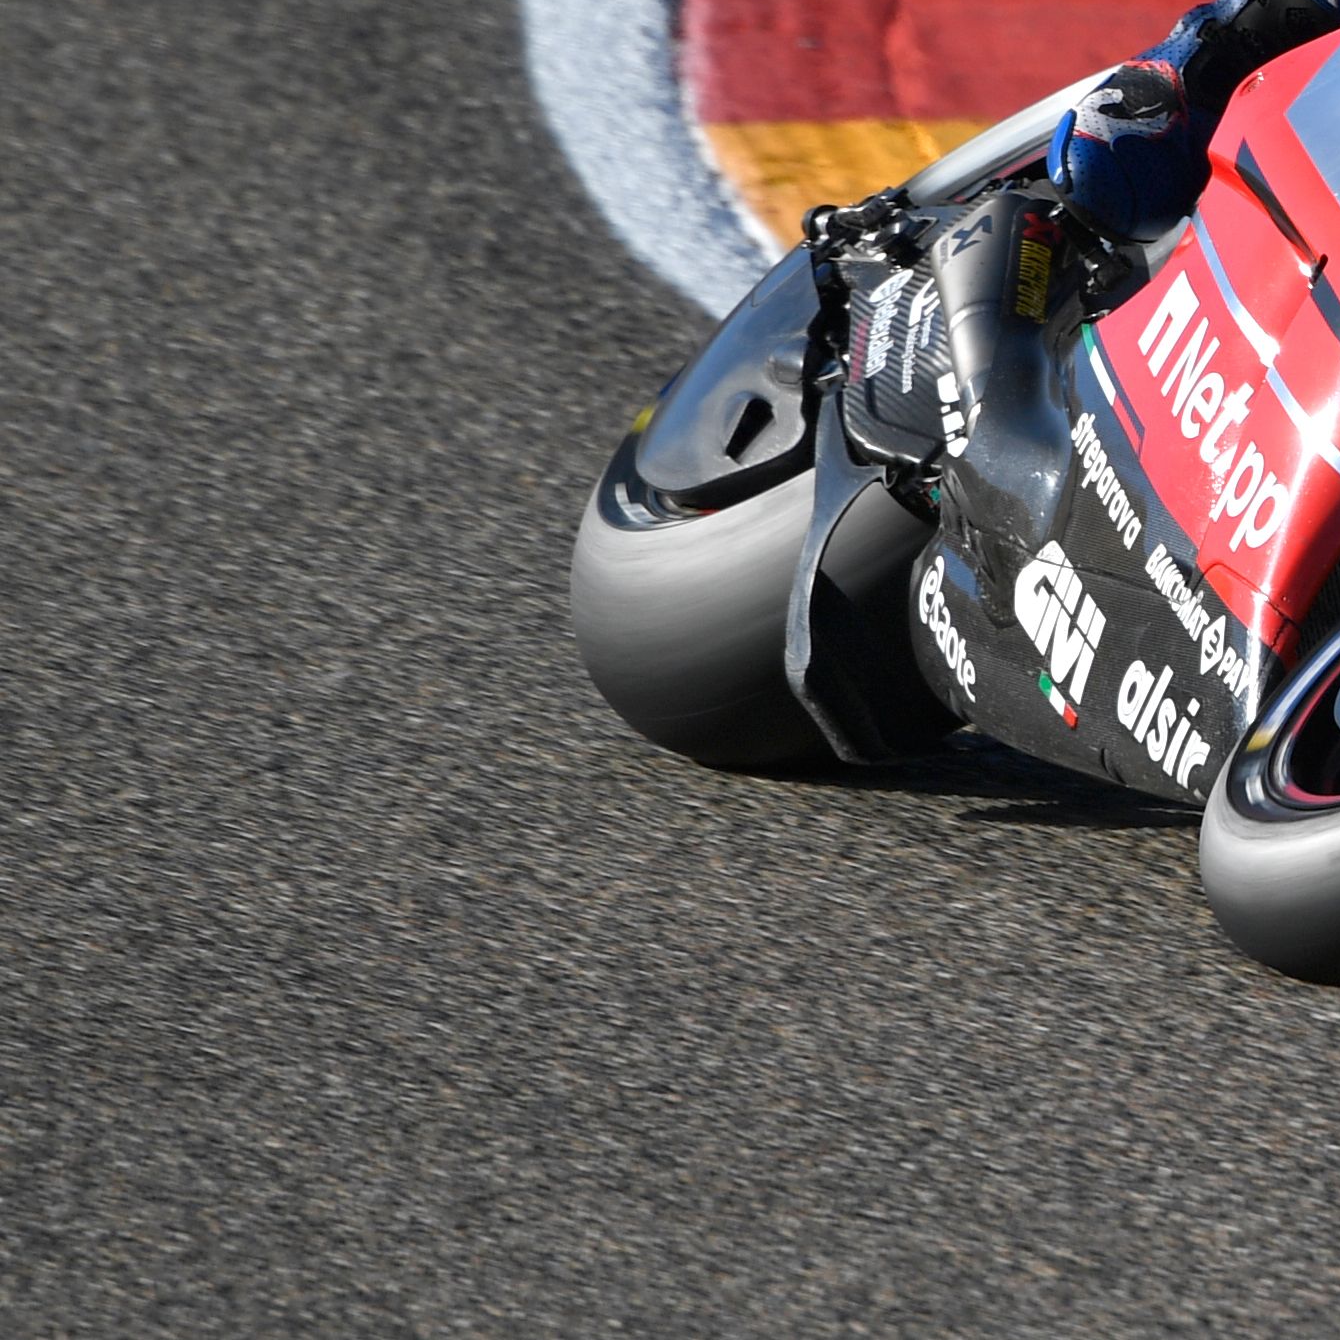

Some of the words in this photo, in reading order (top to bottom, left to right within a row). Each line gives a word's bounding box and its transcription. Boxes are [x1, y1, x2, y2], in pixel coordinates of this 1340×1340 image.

[1071, 412, 1143, 550] streparava
[920, 555, 976, 705] esaote
[1145, 543, 1211, 642] BANCOMAT
[1217, 645, 1253, 698] PAY
